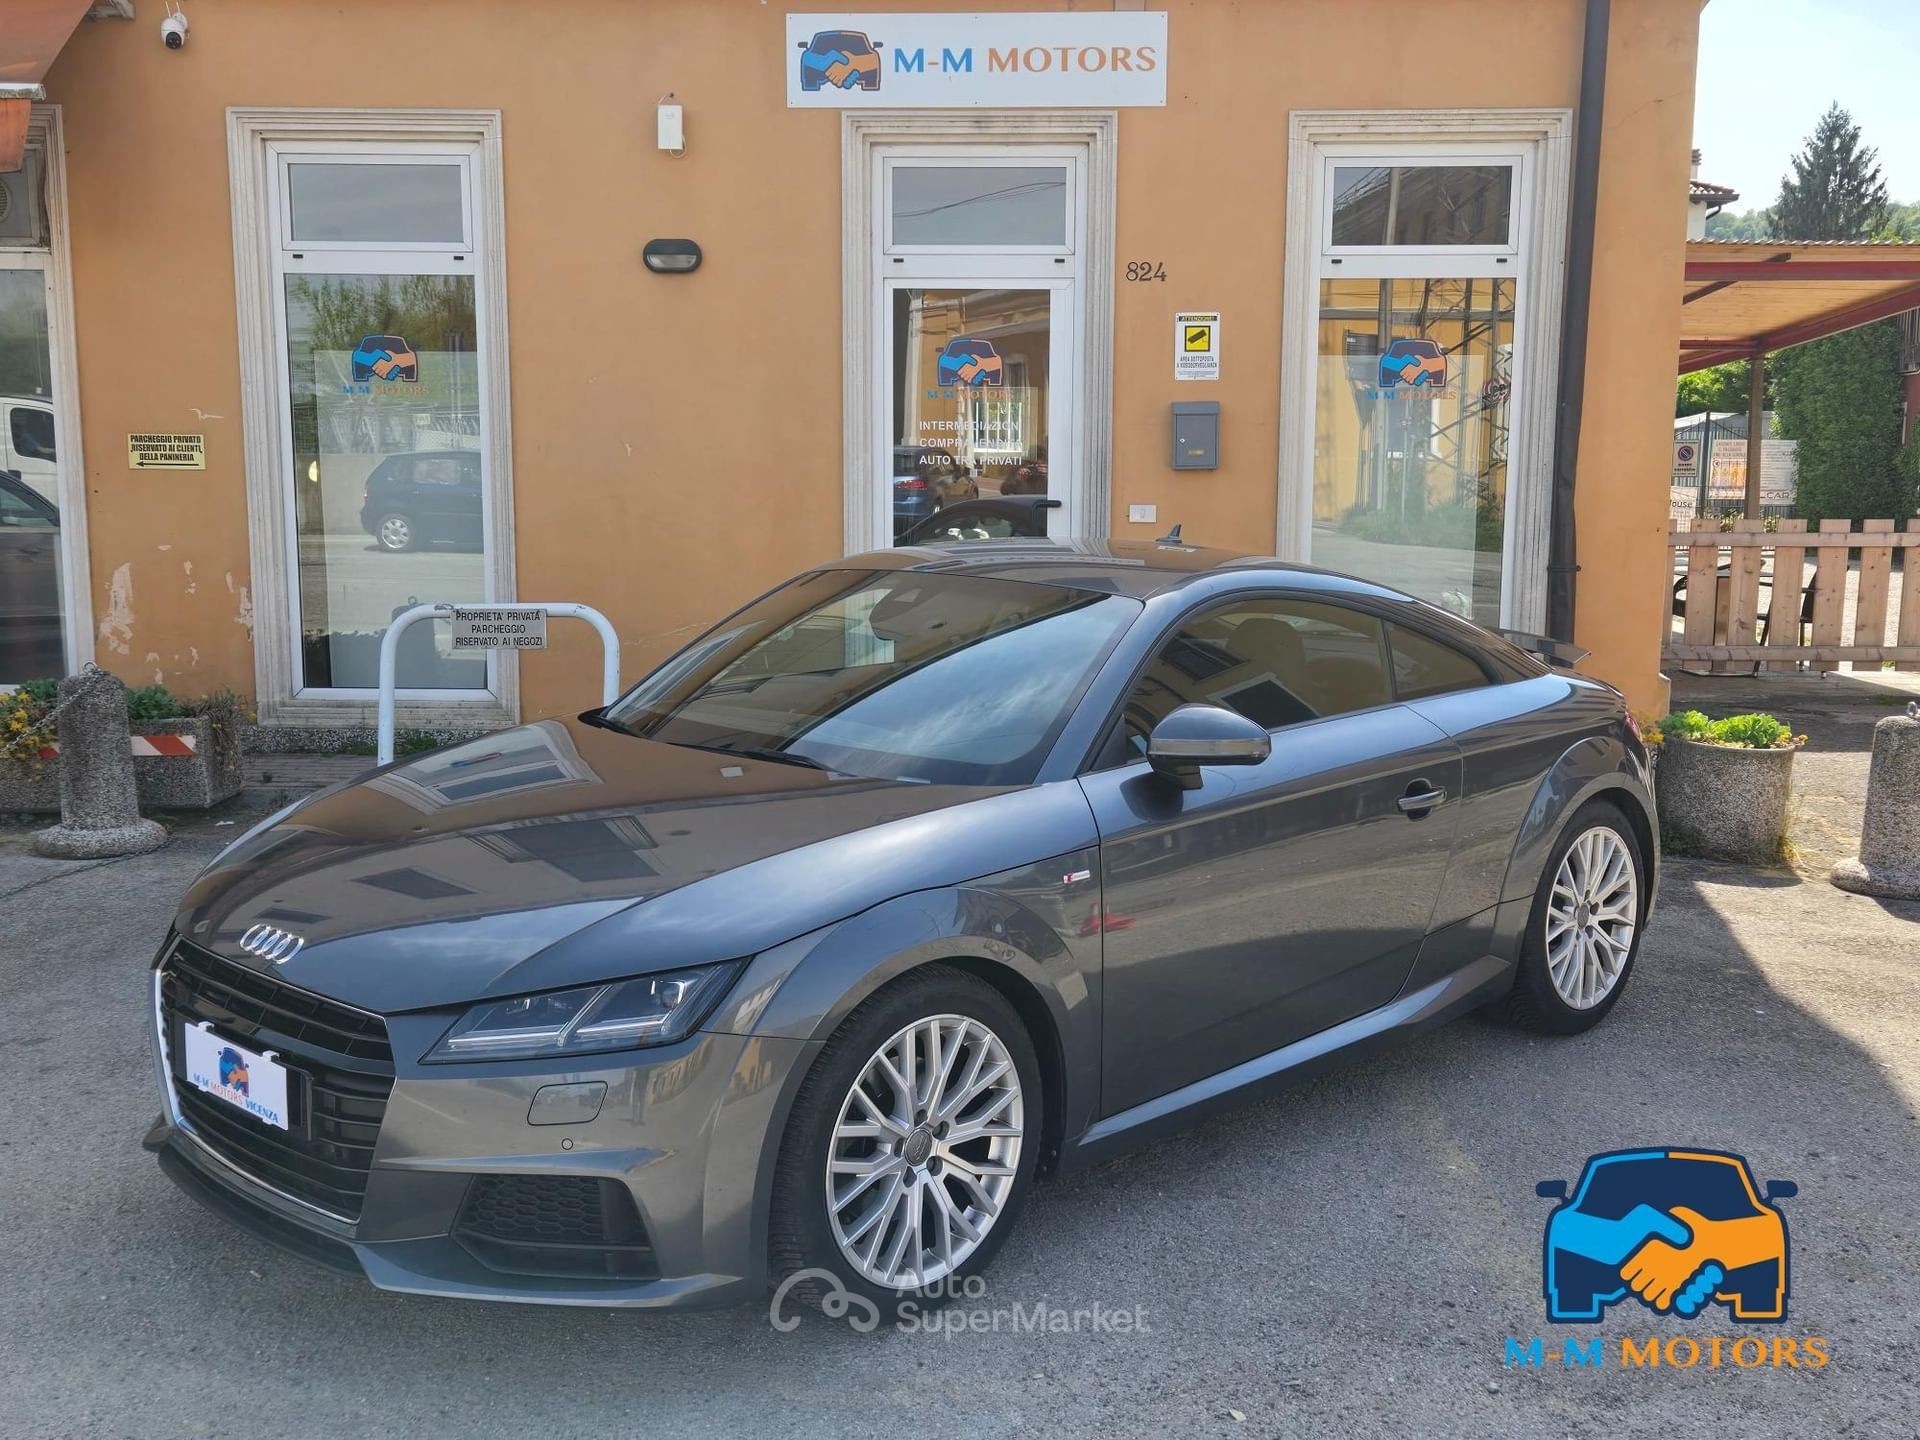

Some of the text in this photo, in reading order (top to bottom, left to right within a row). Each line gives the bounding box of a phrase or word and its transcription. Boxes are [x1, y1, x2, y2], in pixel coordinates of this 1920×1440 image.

[894, 46, 1157, 73] M-M MOTORS
[1126, 261, 1167, 281] 824
[919, 421, 1022, 430] INTERMEDIAZION
[130, 434, 201, 444] PARCHEGGIO PRIVATO
[919, 438, 1023, 448] COMPRAENDITA
[131, 443, 167, 452] RISERVATO
[168, 444, 175, 452] AI
[139, 453, 194, 461] DELLA PANINERIA
[919, 455, 1022, 465] AUTO TRA PRIVATI
[471, 624, 526, 634] PARCHEGGIO
[456, 637, 543, 646] RISERVATO AI NEGOZI
[211, 1081, 243, 1105] MOTORS
[245, 1098, 279, 1123] VICENZA
